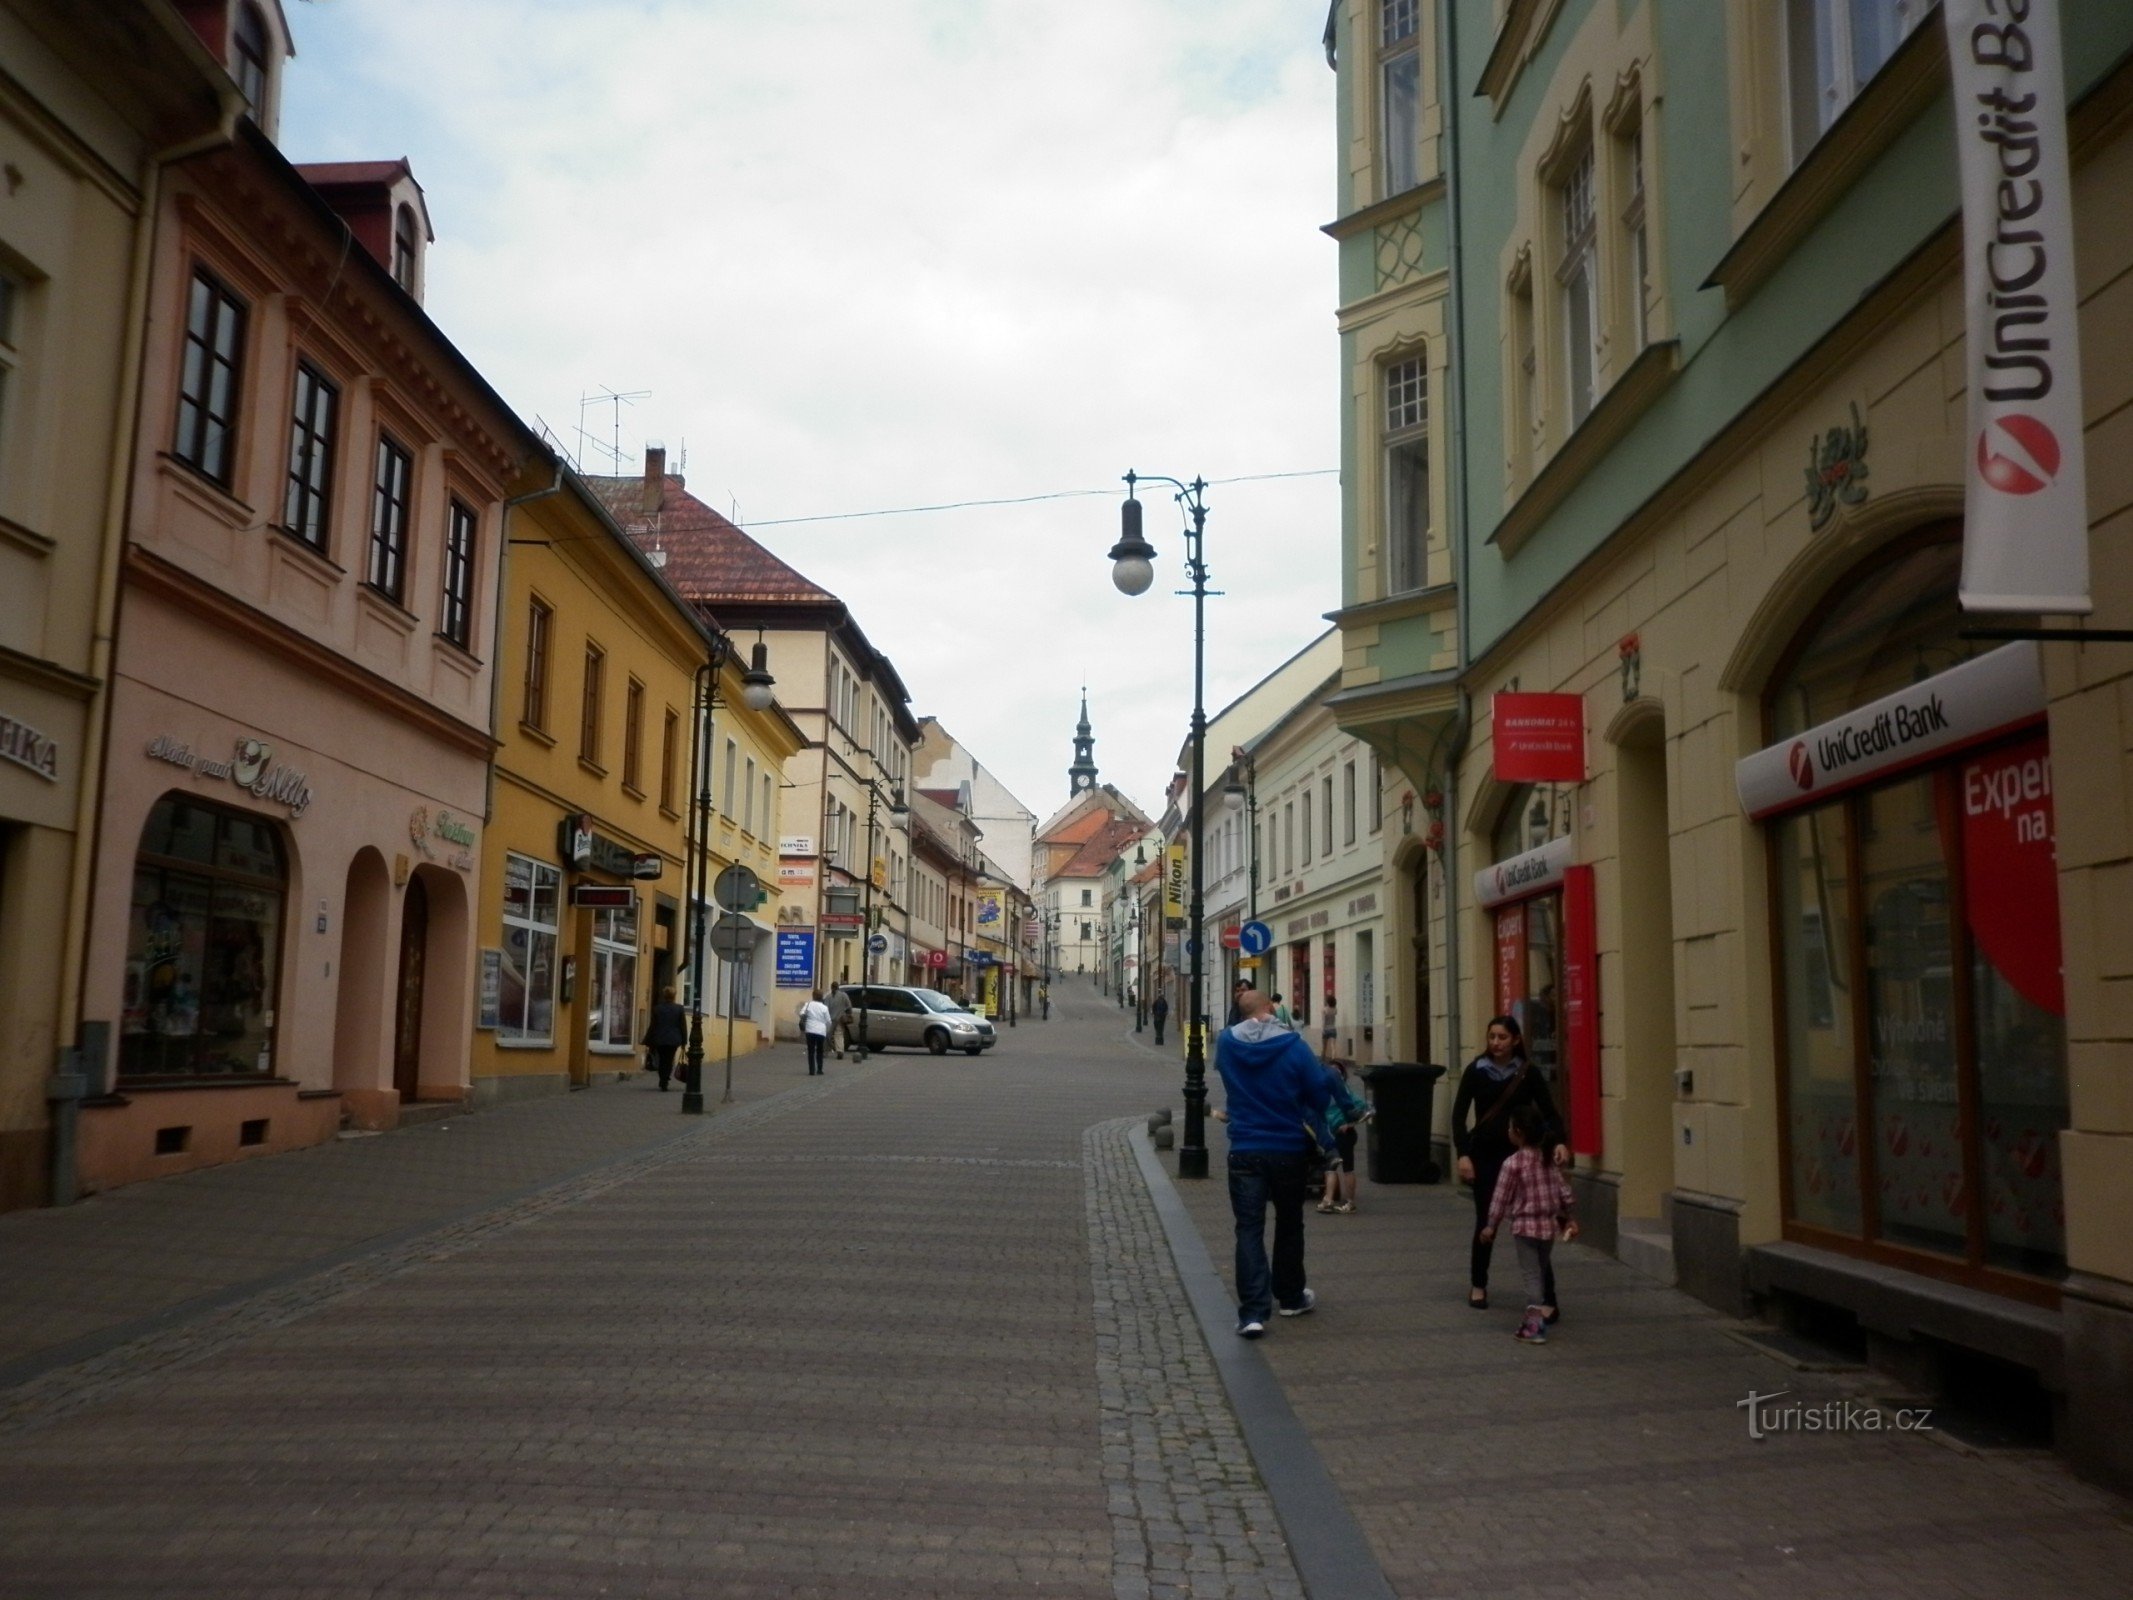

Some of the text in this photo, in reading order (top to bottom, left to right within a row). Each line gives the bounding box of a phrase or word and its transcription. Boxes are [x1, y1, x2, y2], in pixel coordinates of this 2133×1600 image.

[1978, 87, 2053, 402] UniCredit
[1504, 717, 1556, 728] BANKOMAT
[1818, 693, 1949, 772] UniCredit Bank
[2017, 810, 2047, 844] na
[1169, 858, 1183, 905] Nikon
